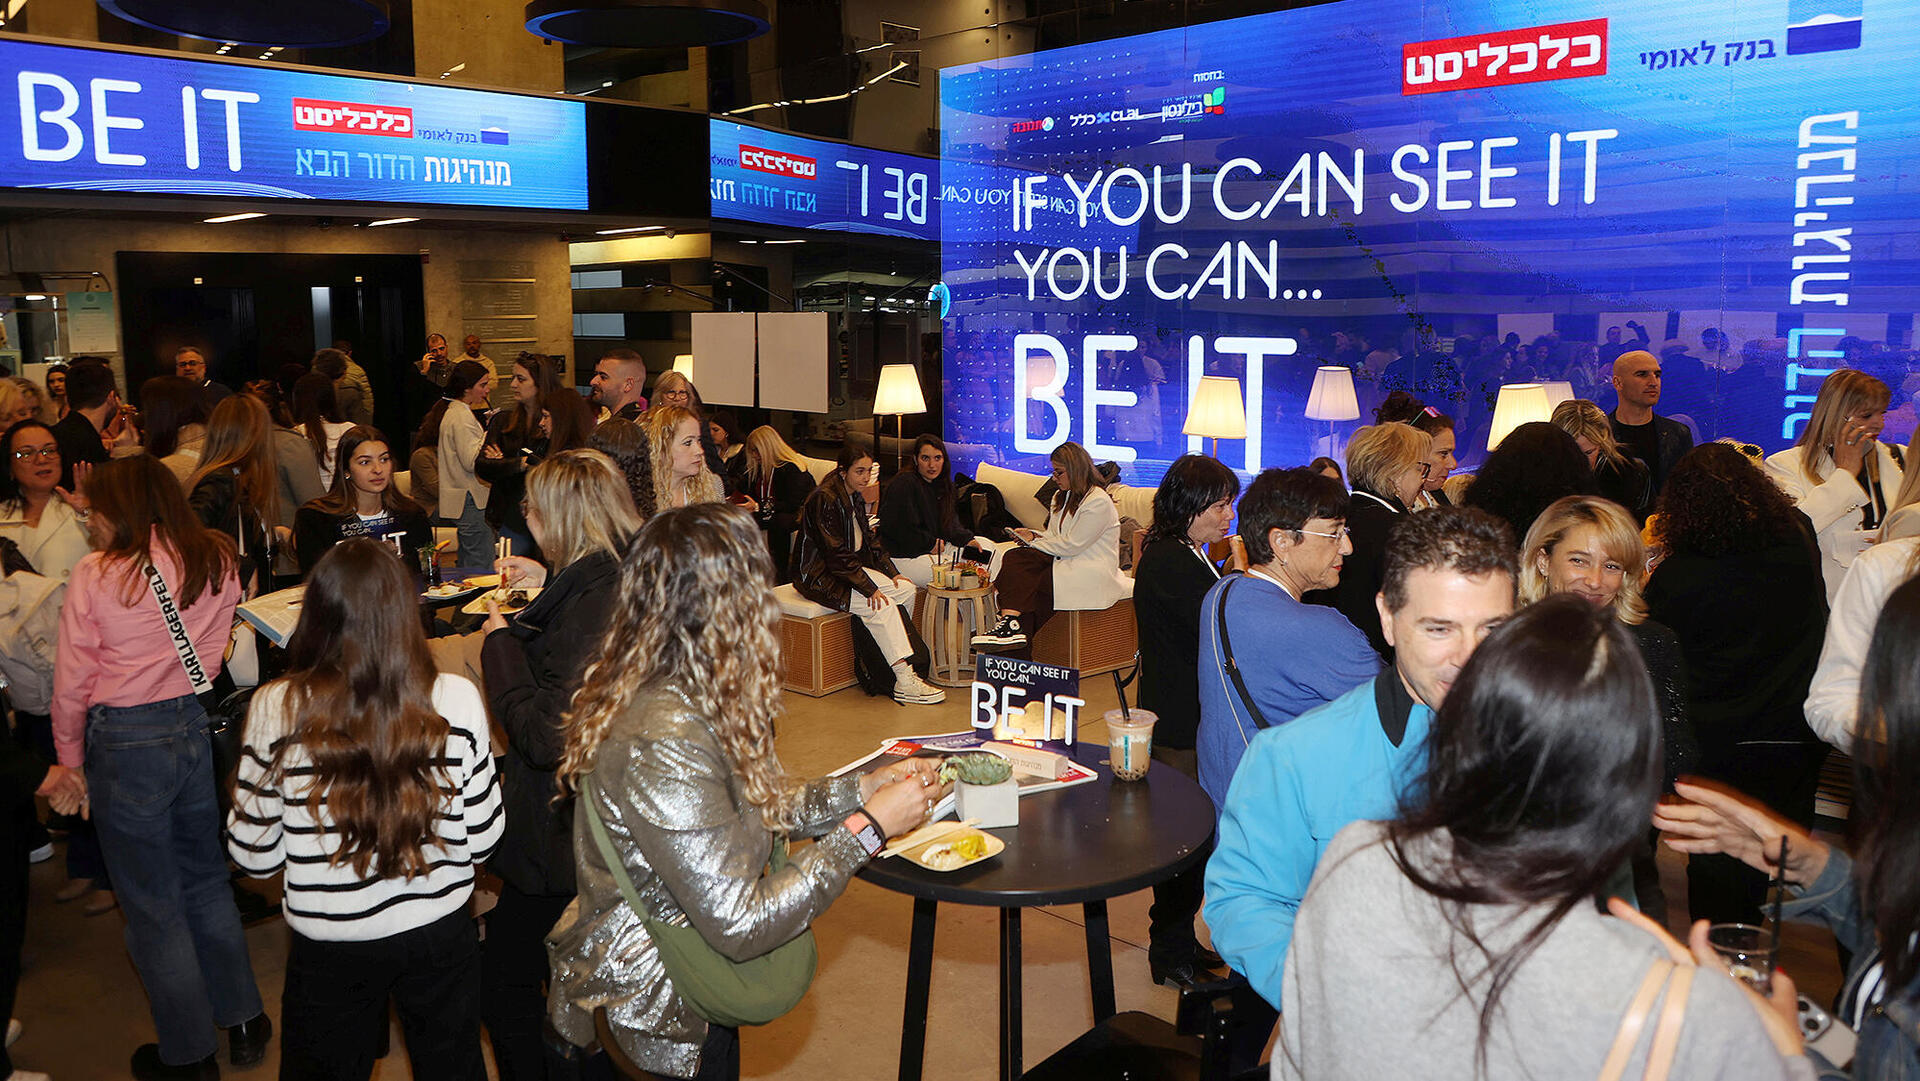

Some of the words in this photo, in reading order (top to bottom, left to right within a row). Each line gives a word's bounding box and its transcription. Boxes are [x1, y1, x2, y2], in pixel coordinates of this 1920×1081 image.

[1406, 34, 1601, 85] כלכליסט
[1640, 40, 1716, 71] לאומי
[1725, 38, 1775, 68] בנק
[18, 71, 146, 166] BE
[182, 86, 260, 172] IT
[296, 106, 411, 132] כלכליסט
[1070, 114, 1096, 127] כלל
[418, 129, 452, 141] לאומי
[456, 131, 477, 144] בנק
[296, 148, 349, 178] הבא
[358, 152, 415, 181] הדור
[424, 156, 512, 186] מנהיגות
[1013, 175, 1048, 232] IF
[1063, 162, 1191, 228] YOU
[1212, 148, 1364, 220] CAN
[1390, 136, 1518, 213] SEE
[1548, 128, 1618, 206] IT
[1790, 110, 1859, 306] מנהיגות
[1013, 244, 1127, 301] YOU
[1146, 239, 1322, 300] CAN...
[1014, 333, 1138, 463] BE
[985, 657, 993, 668] IF
[995, 659, 1017, 672] YOU
[1018, 663, 1041, 676] CAN
[1042, 666, 1060, 679] SEE
[1061, 669, 1071, 680] IT
[985, 668, 1007, 680] YOU
[971, 681, 1026, 735] BE
[1044, 692, 1086, 746] IT
